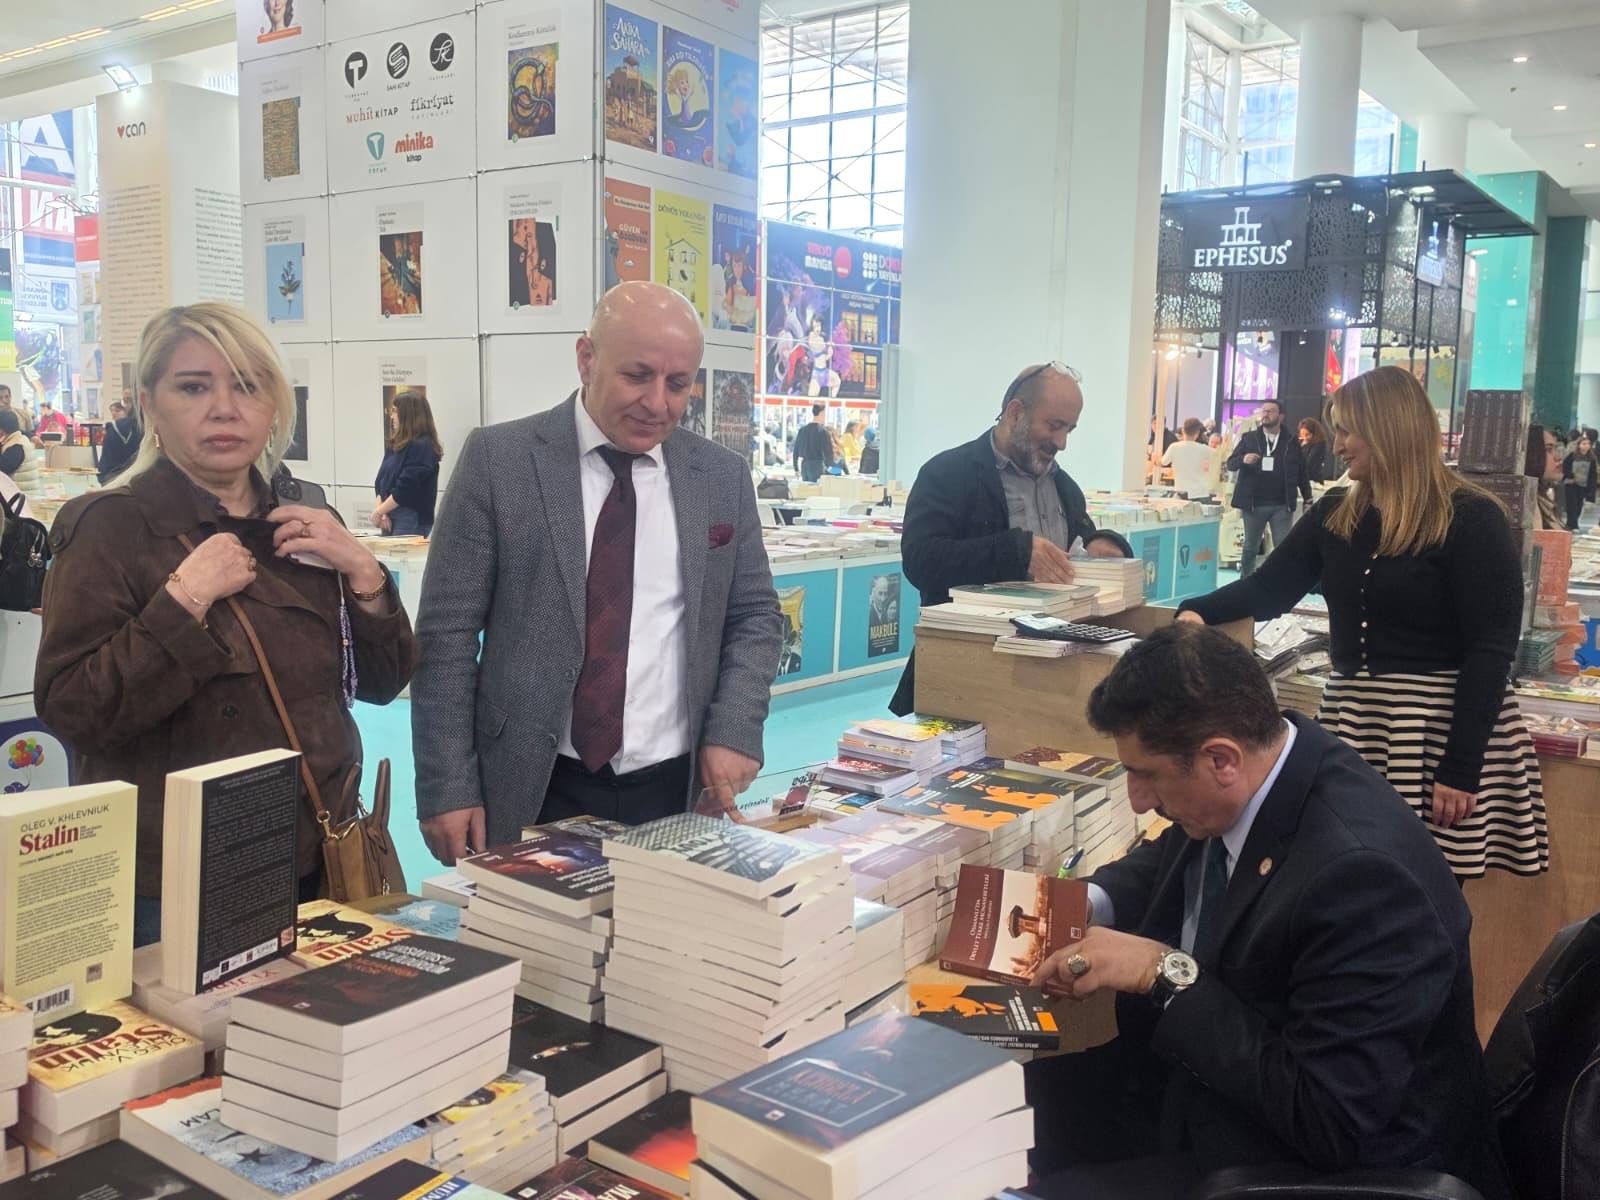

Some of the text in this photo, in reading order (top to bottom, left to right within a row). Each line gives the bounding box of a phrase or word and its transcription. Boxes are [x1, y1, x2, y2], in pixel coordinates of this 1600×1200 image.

[375, 106, 399, 119] KİTAP
[410, 94, 454, 112] fikriyat
[125, 121, 147, 138] can
[394, 131, 434, 153] minika
[1194, 244, 1288, 267] EPHESUS
[870, 621, 898, 640] MAKBULE
[20, 819, 46, 833] OLEG
[58, 803, 110, 823] KHLEVNIUK
[19, 824, 79, 856] Stalin
[37, 1024, 175, 1069] Stalin
